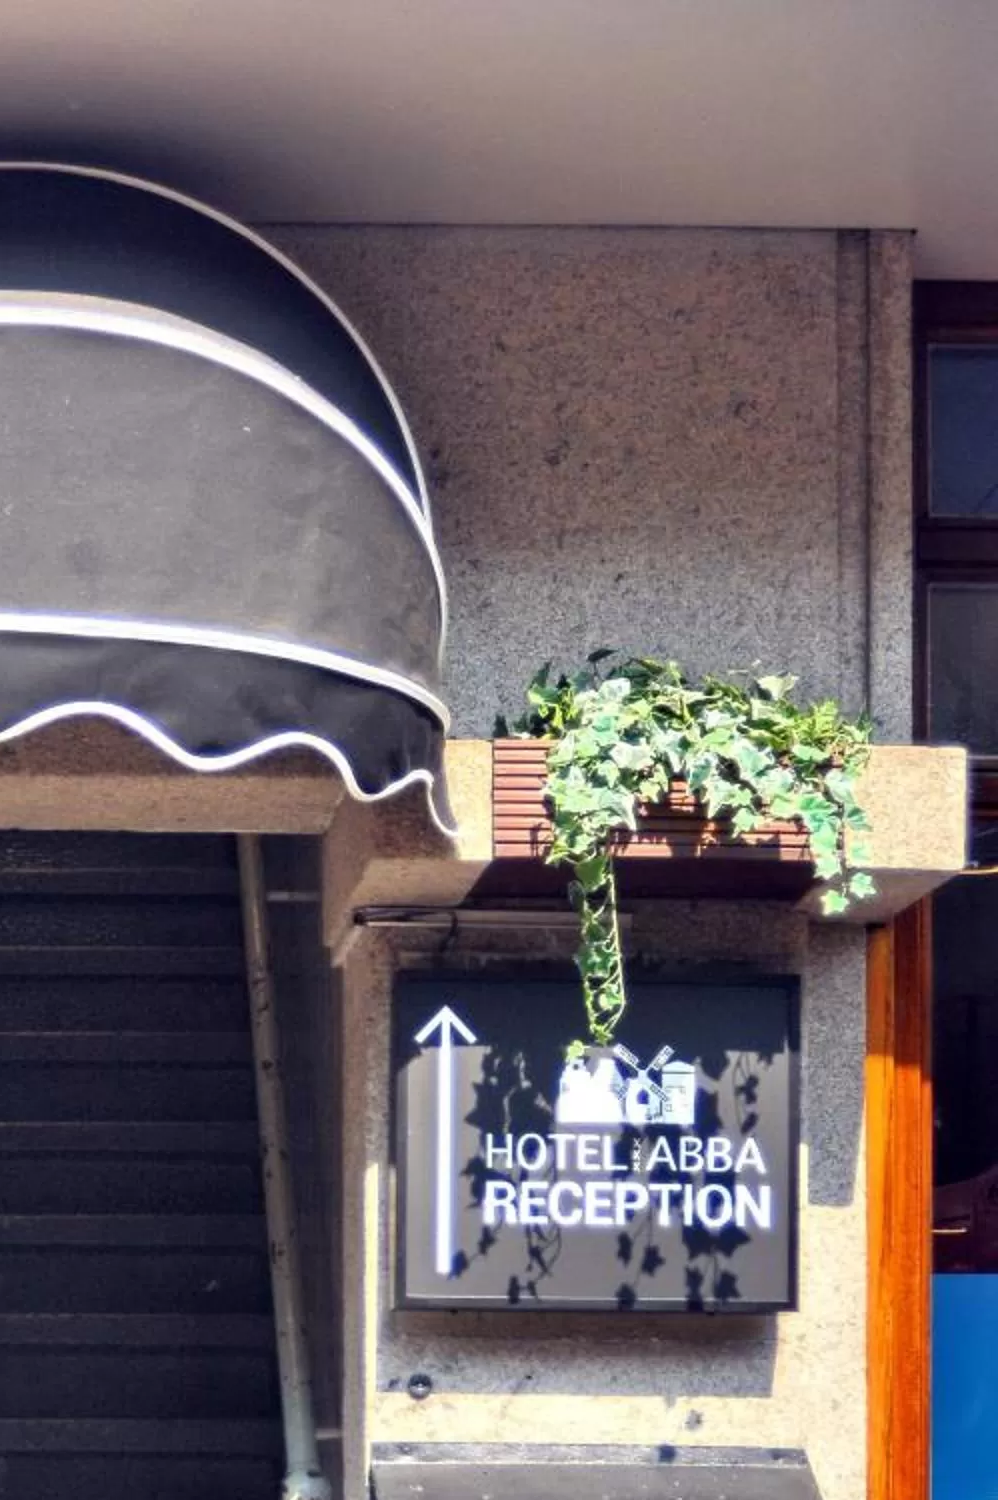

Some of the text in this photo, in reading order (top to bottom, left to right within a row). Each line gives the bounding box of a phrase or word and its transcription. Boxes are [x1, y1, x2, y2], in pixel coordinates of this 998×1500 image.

[486, 1133, 628, 1172] HOTEL
[645, 1136, 766, 1174] ABBA
[482, 1180, 772, 1229] RECEPTION
